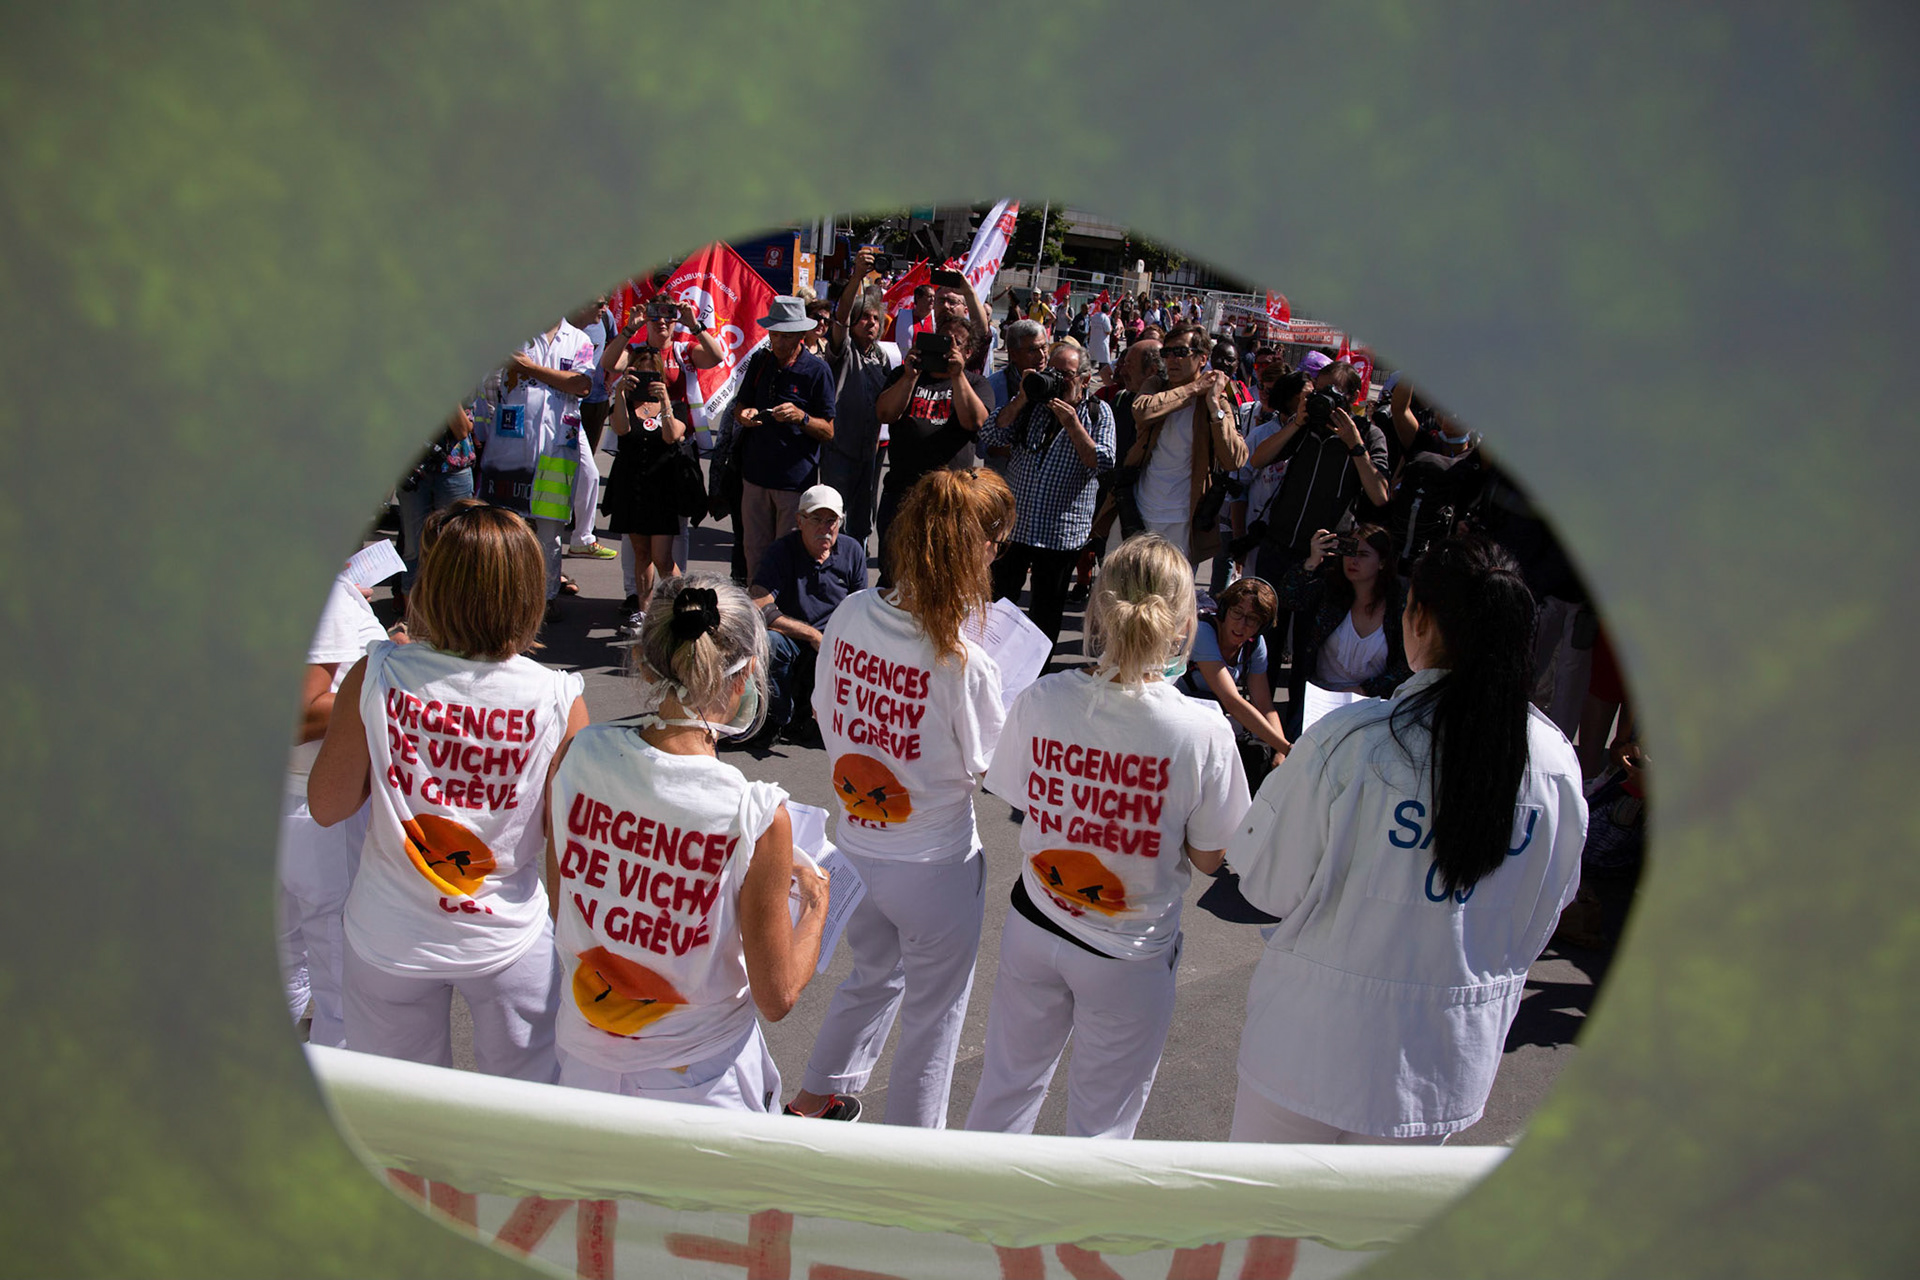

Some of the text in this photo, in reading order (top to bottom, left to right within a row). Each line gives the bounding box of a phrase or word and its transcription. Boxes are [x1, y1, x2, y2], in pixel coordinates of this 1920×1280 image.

[1306, 334, 1331, 342] PUBLIC
[909, 397, 951, 420] RIEN
[834, 637, 930, 699] URGENCES
[387, 688, 536, 743] URGENCES
[834, 674, 925, 729] E VICHY
[428, 739, 530, 776] VICHY
[1032, 736, 1171, 792] URGENCES
[1028, 771, 1164, 826] DE VICHY
[560, 839, 610, 889] DE
